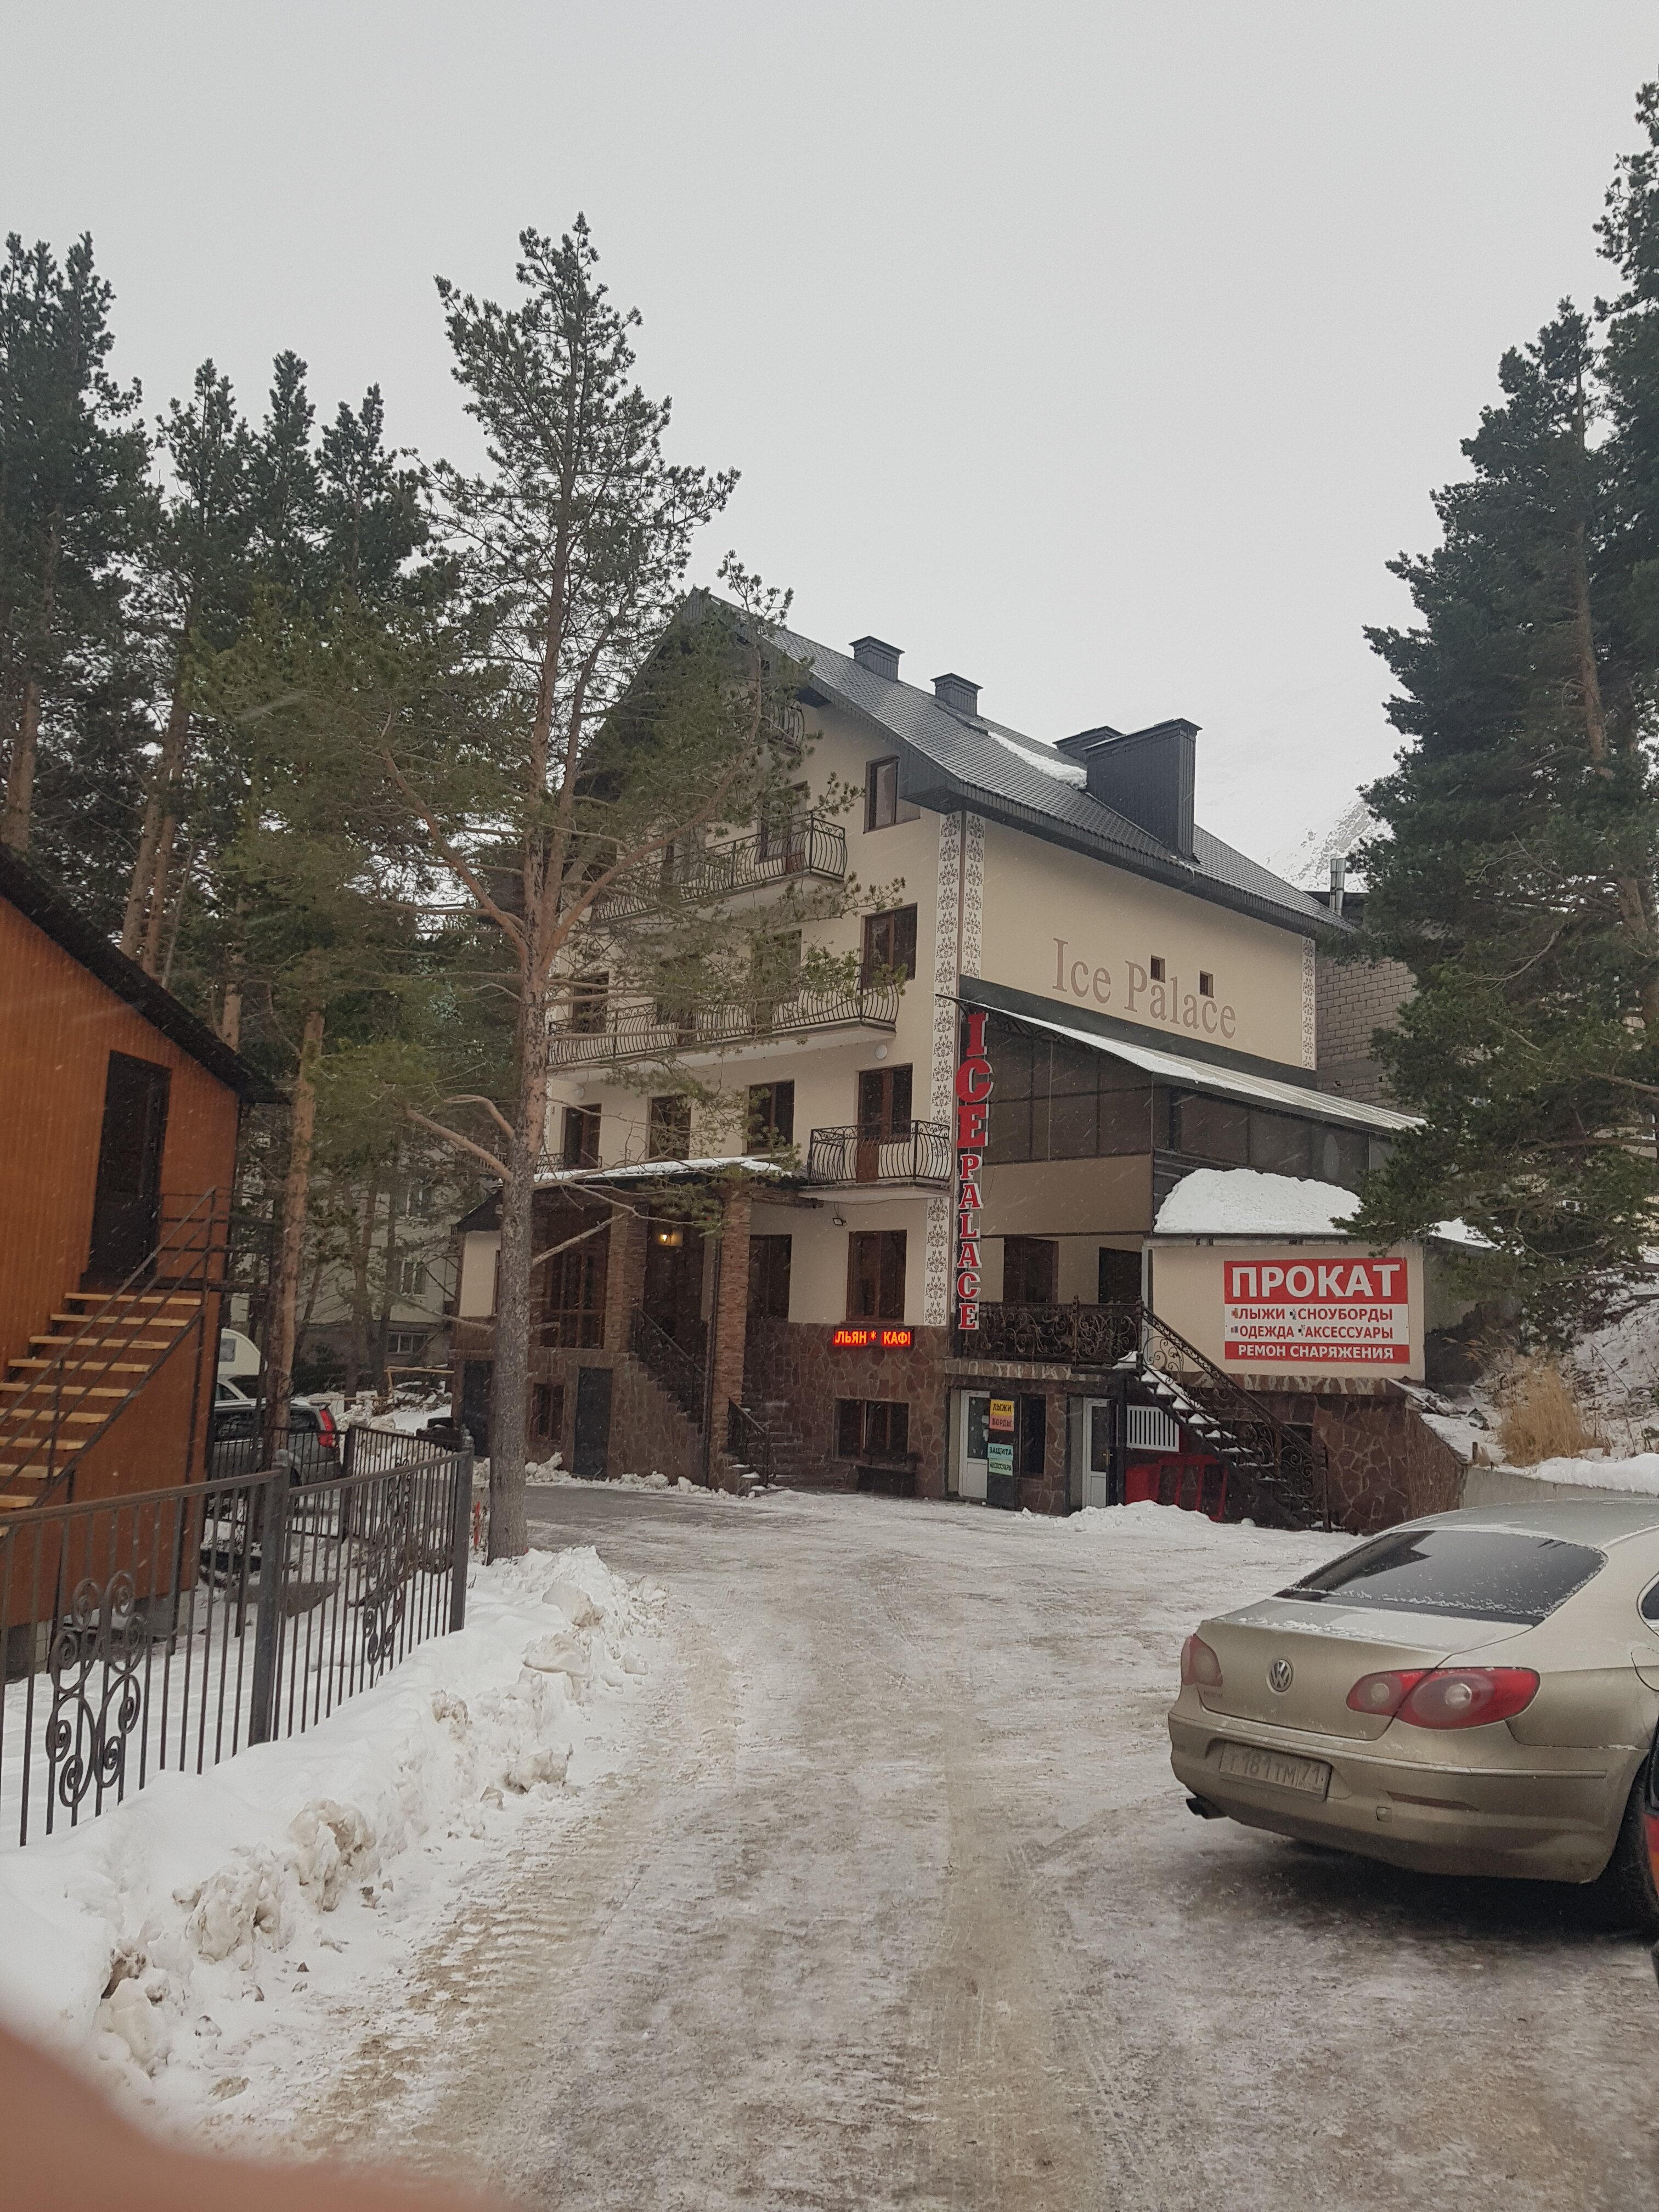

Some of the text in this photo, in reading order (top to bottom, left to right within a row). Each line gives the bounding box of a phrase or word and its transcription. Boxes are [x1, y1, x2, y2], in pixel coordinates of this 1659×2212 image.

[1052, 938, 1236, 1039] Ice Palace
[956, 1012, 994, 1330] ICE PALACE
[1232, 1264, 1400, 1297] ПРОКАТ
[1238, 1308, 1393, 1323] ЛЫЖИ СНОУБОРДЫ
[1239, 1325, 1393, 1339] ОДЕЖДА АКСЕССУАРЫ
[1238, 1344, 1393, 1359] РЕМОН СНАРЯЖЕНИЯ
[992, 1403, 1012, 1413] ЛЫЖИ
[992, 1418, 1012, 1427] БОРДЫ
[989, 1446, 1012, 1456] ЗАЩИТА
